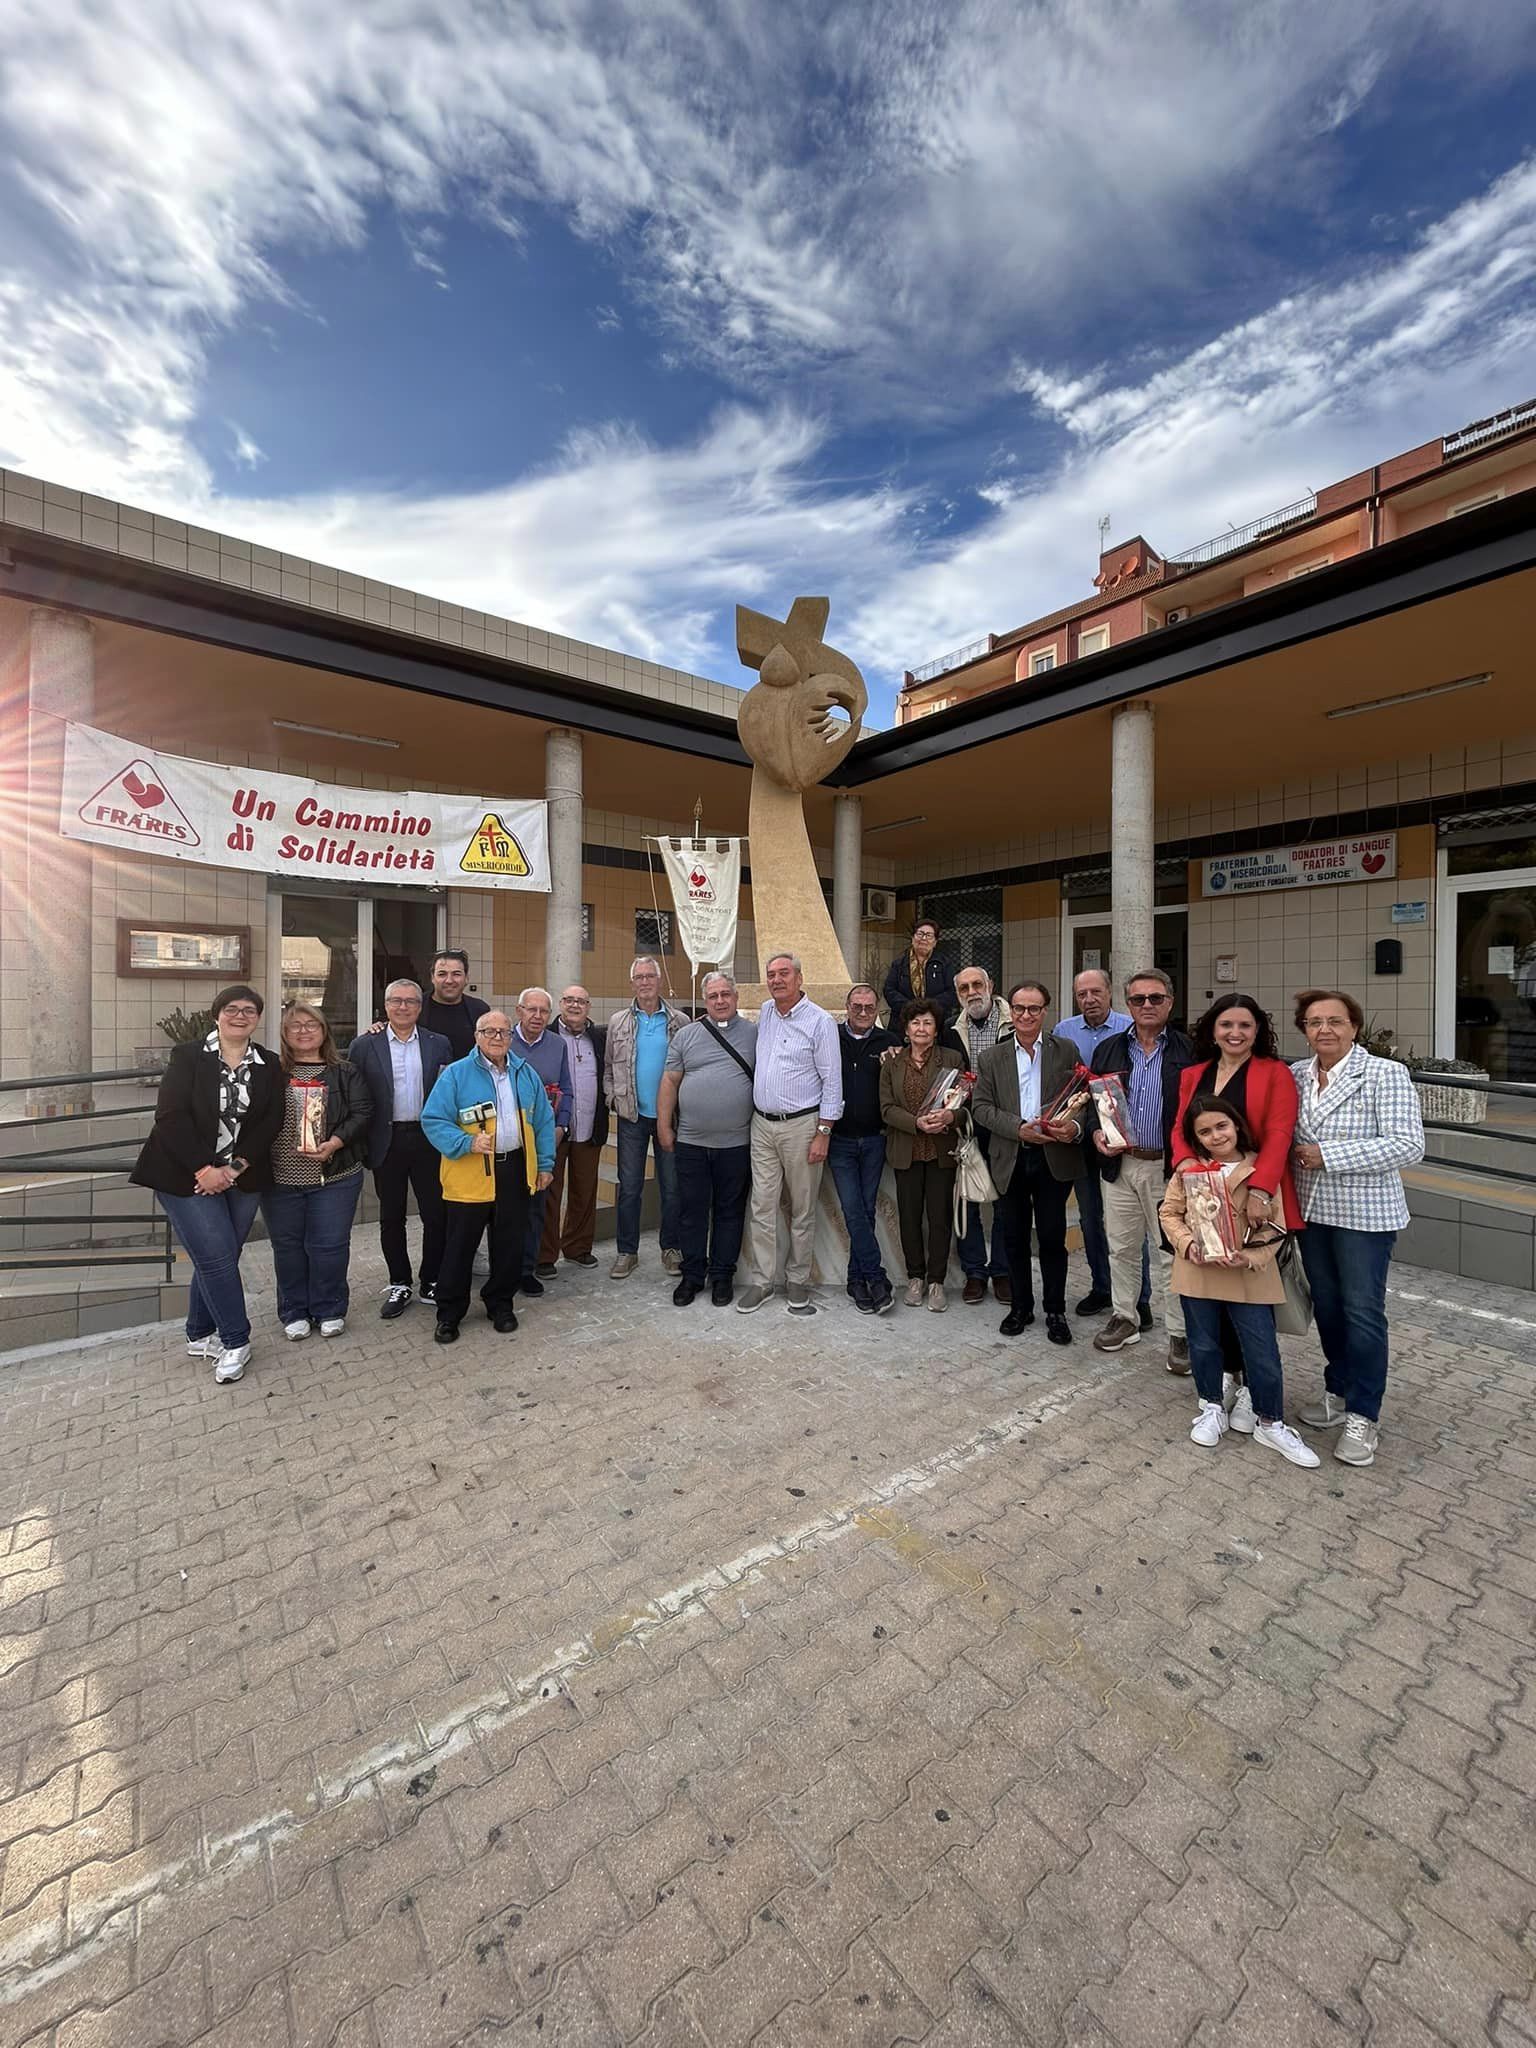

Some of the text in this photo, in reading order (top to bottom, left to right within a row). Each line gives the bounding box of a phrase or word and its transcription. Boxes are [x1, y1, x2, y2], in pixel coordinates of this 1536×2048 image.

[231, 790, 431, 837] Un Cammino
[227, 824, 435, 870] di Solidarietà
[1292, 838, 1391, 861] DONATORI DI SANGUE
[466, 861, 525, 873] MISERICORDIE
[1265, 854, 1274, 865] DI
[1303, 856, 1346, 871] FRATRES
[1230, 863, 1288, 880] MISERICORDIA
[1233, 879, 1266, 890] PRESIDENTE
